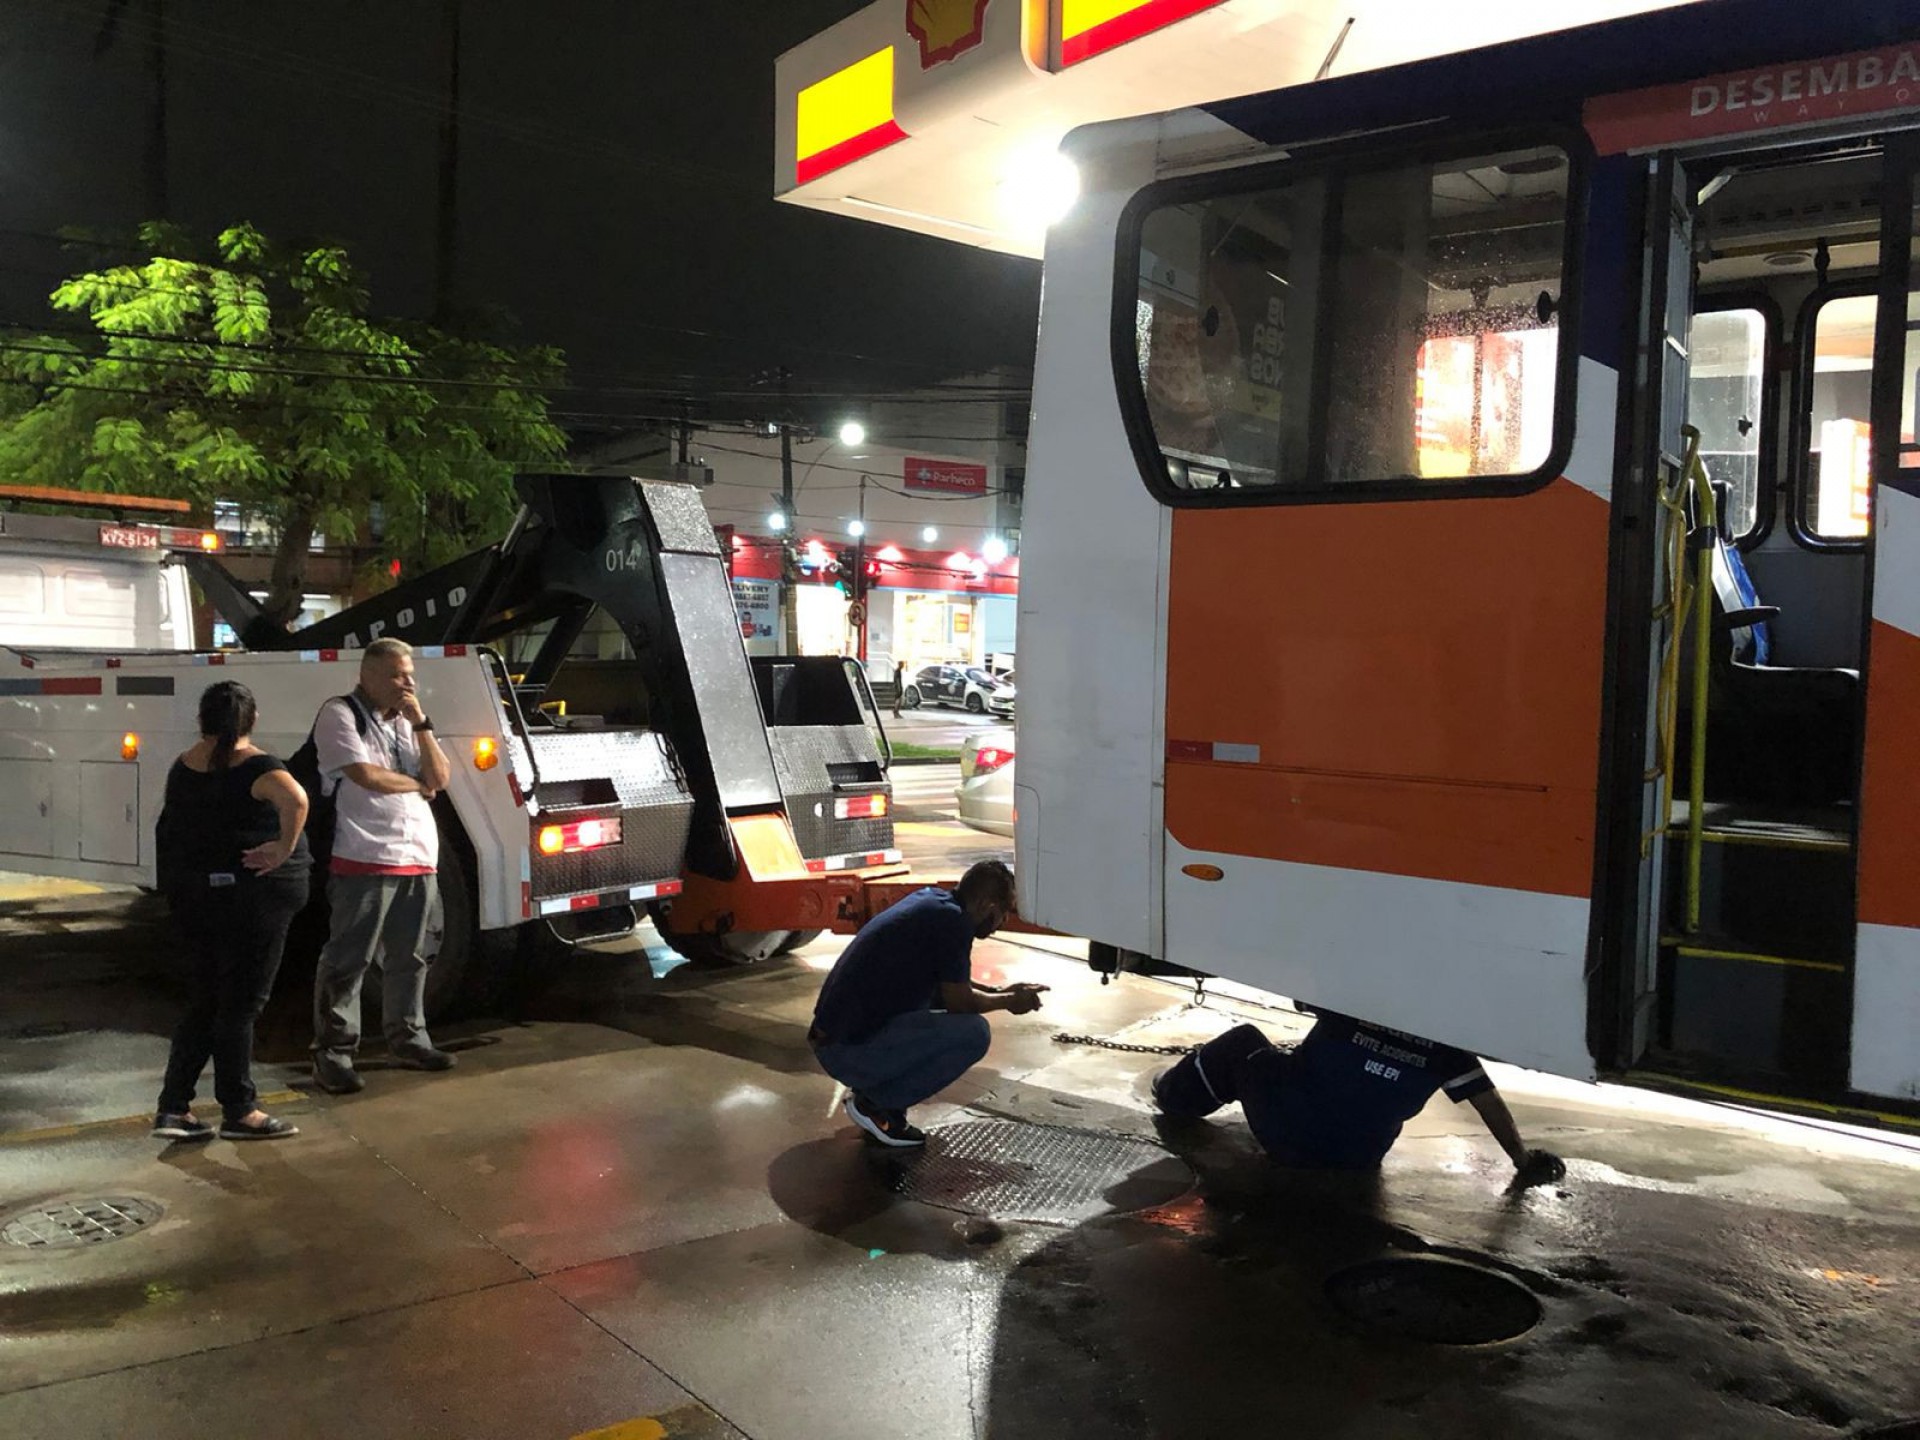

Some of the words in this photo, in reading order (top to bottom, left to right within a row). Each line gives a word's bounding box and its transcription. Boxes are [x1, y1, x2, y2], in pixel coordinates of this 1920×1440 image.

[1753, 98, 1846, 123] WAY
[605, 549, 637, 571] 014
[343, 586, 467, 649] APOIO
[1352, 1031, 1382, 1053] EVITE
[1364, 1059, 1386, 1076] USE
[1383, 1066, 1401, 1082] EPI
